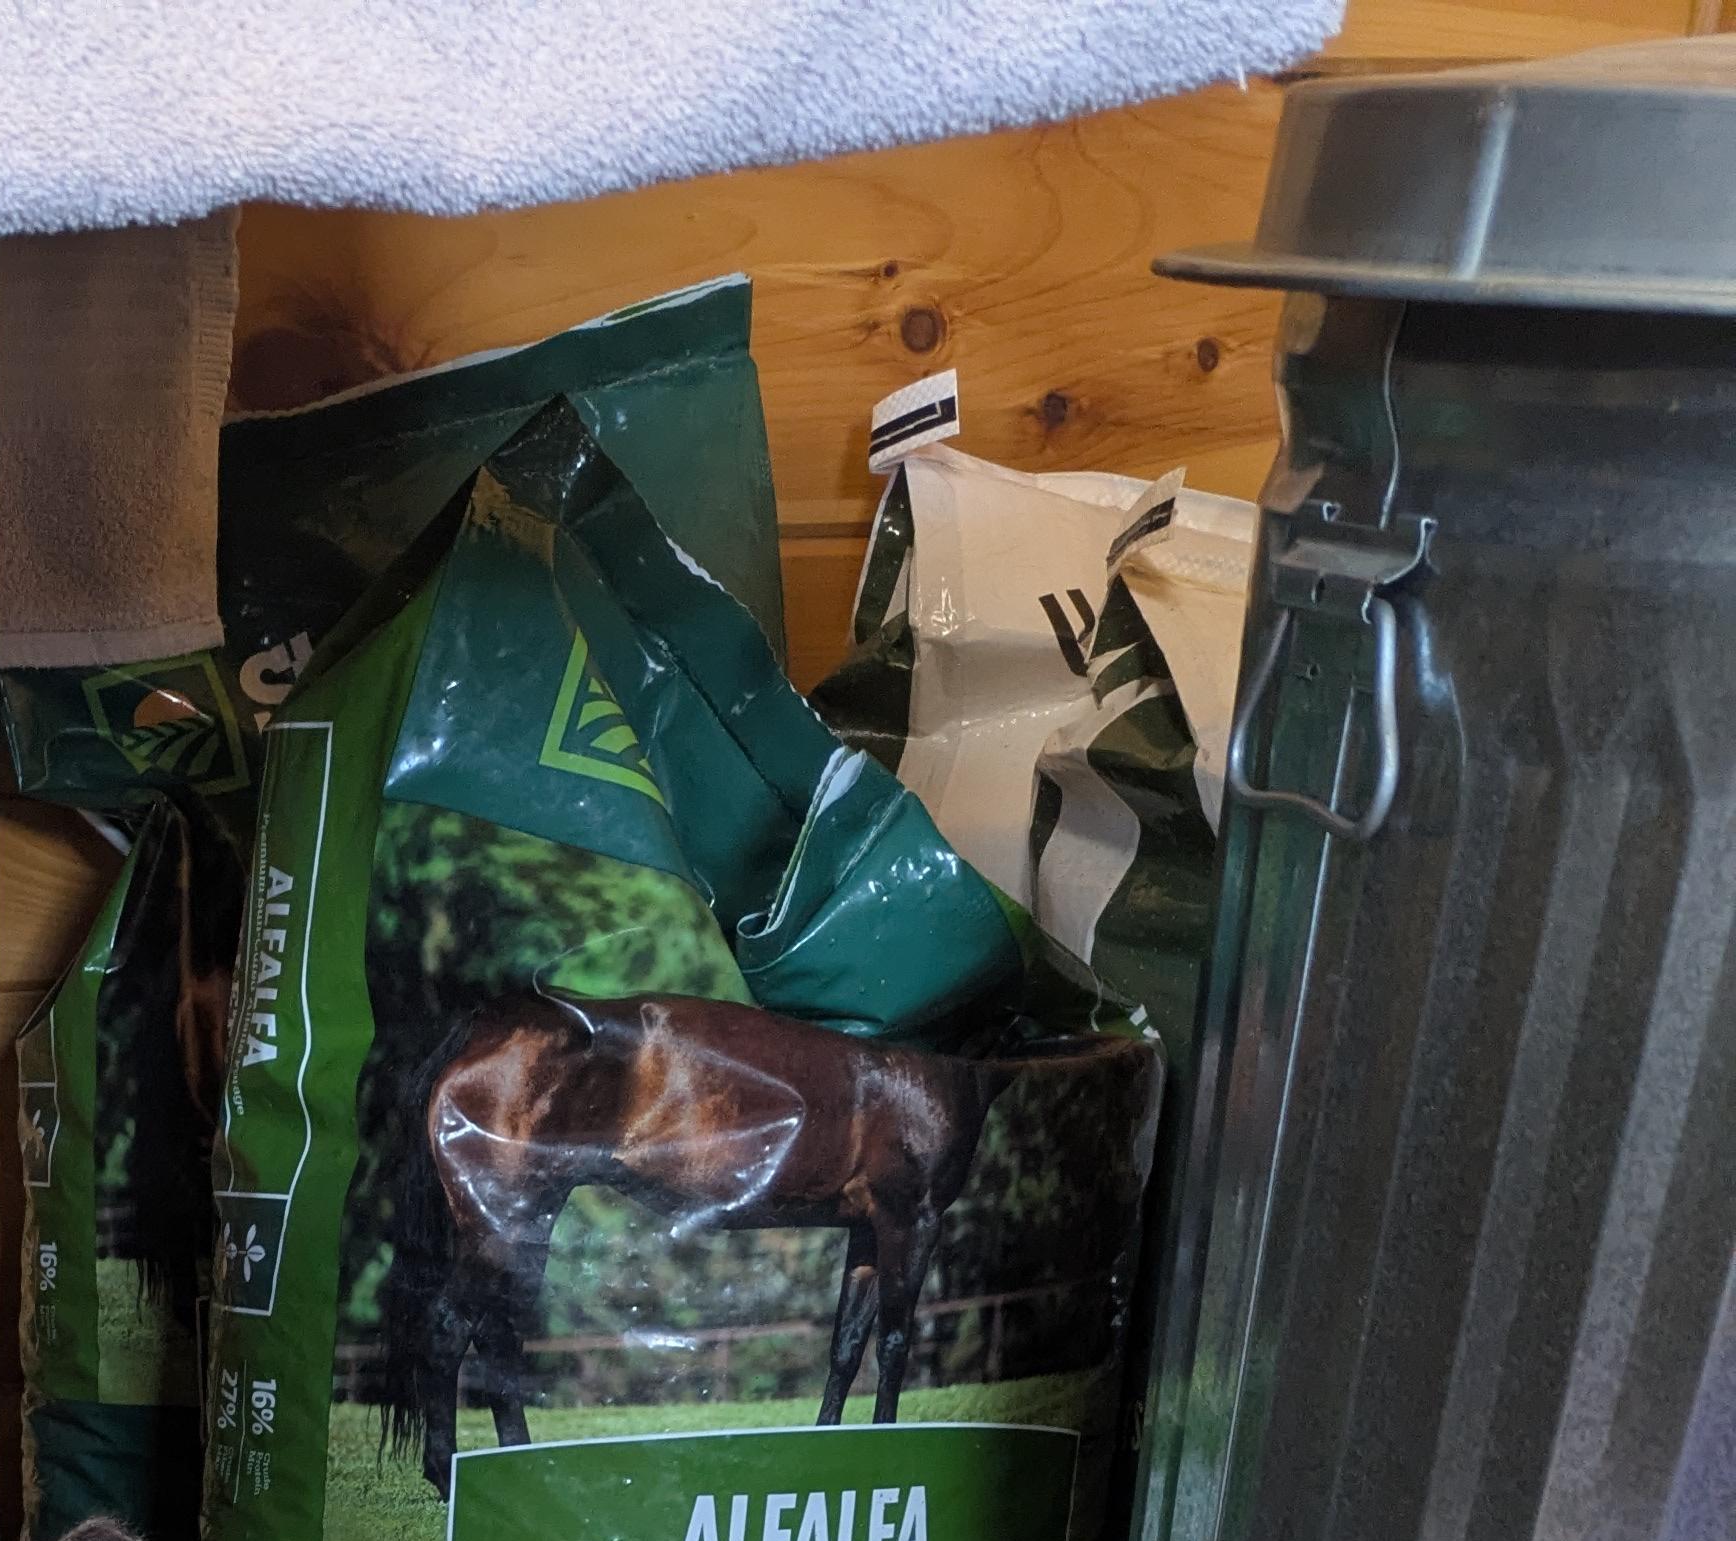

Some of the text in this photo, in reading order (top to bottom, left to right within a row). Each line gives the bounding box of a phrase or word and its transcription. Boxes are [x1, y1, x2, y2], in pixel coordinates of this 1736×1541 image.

[242, 866, 294, 1069] ALFALFA
[38, 1240, 59, 1292] 16%
[216, 1368, 238, 1429] 27%
[250, 1378, 278, 1436] 16%
